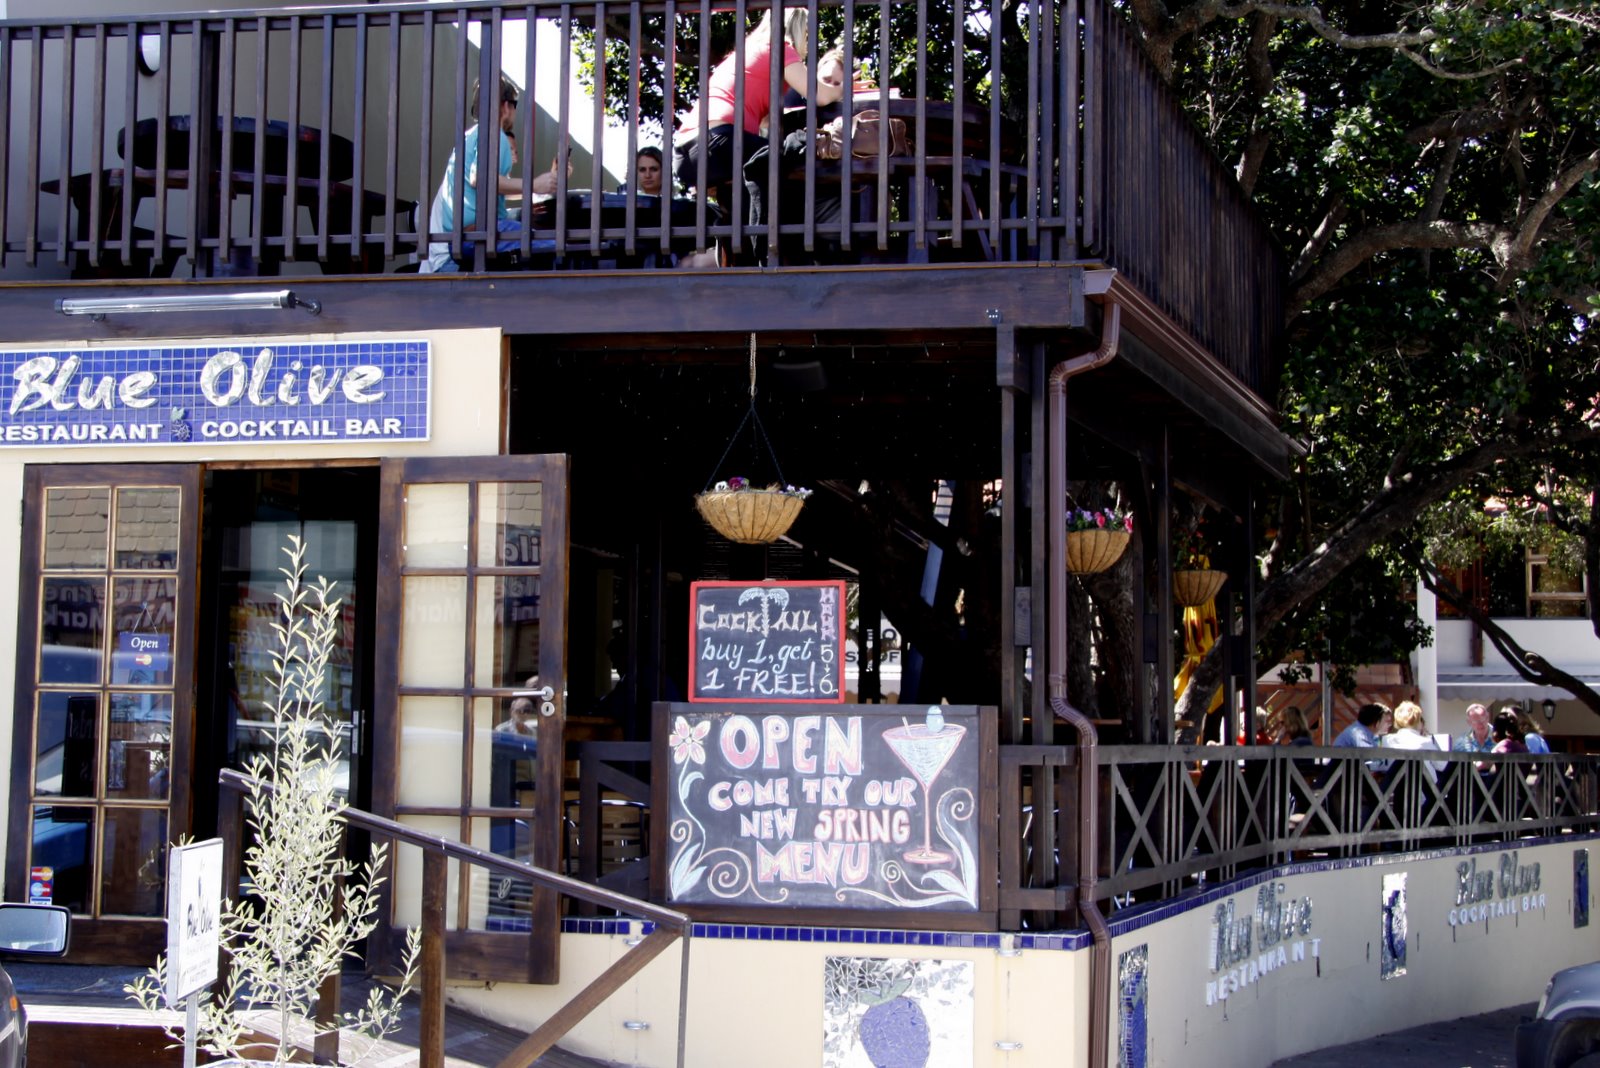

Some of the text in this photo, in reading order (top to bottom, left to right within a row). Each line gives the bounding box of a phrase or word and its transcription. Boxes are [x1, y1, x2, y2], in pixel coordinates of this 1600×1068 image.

[10, 348, 387, 415] Blue Olive
[0, 418, 402, 441] ESTAURANT COCKTAIL BAR
[131, 637, 159, 652] Open
[701, 637, 744, 670] buy
[772, 637, 815, 674] get
[820, 641, 834, 664] 5
[701, 661, 816, 695] 1 FREE!
[720, 714, 863, 776] OPEN
[708, 776, 918, 811] COME TRY OUR
[740, 808, 911, 843] NEW SPRING
[756, 840, 871, 888] MENU
[1447, 893, 1546, 926] COCKTAIL BAR
[1205, 938, 1321, 1007] RESTAURANT
